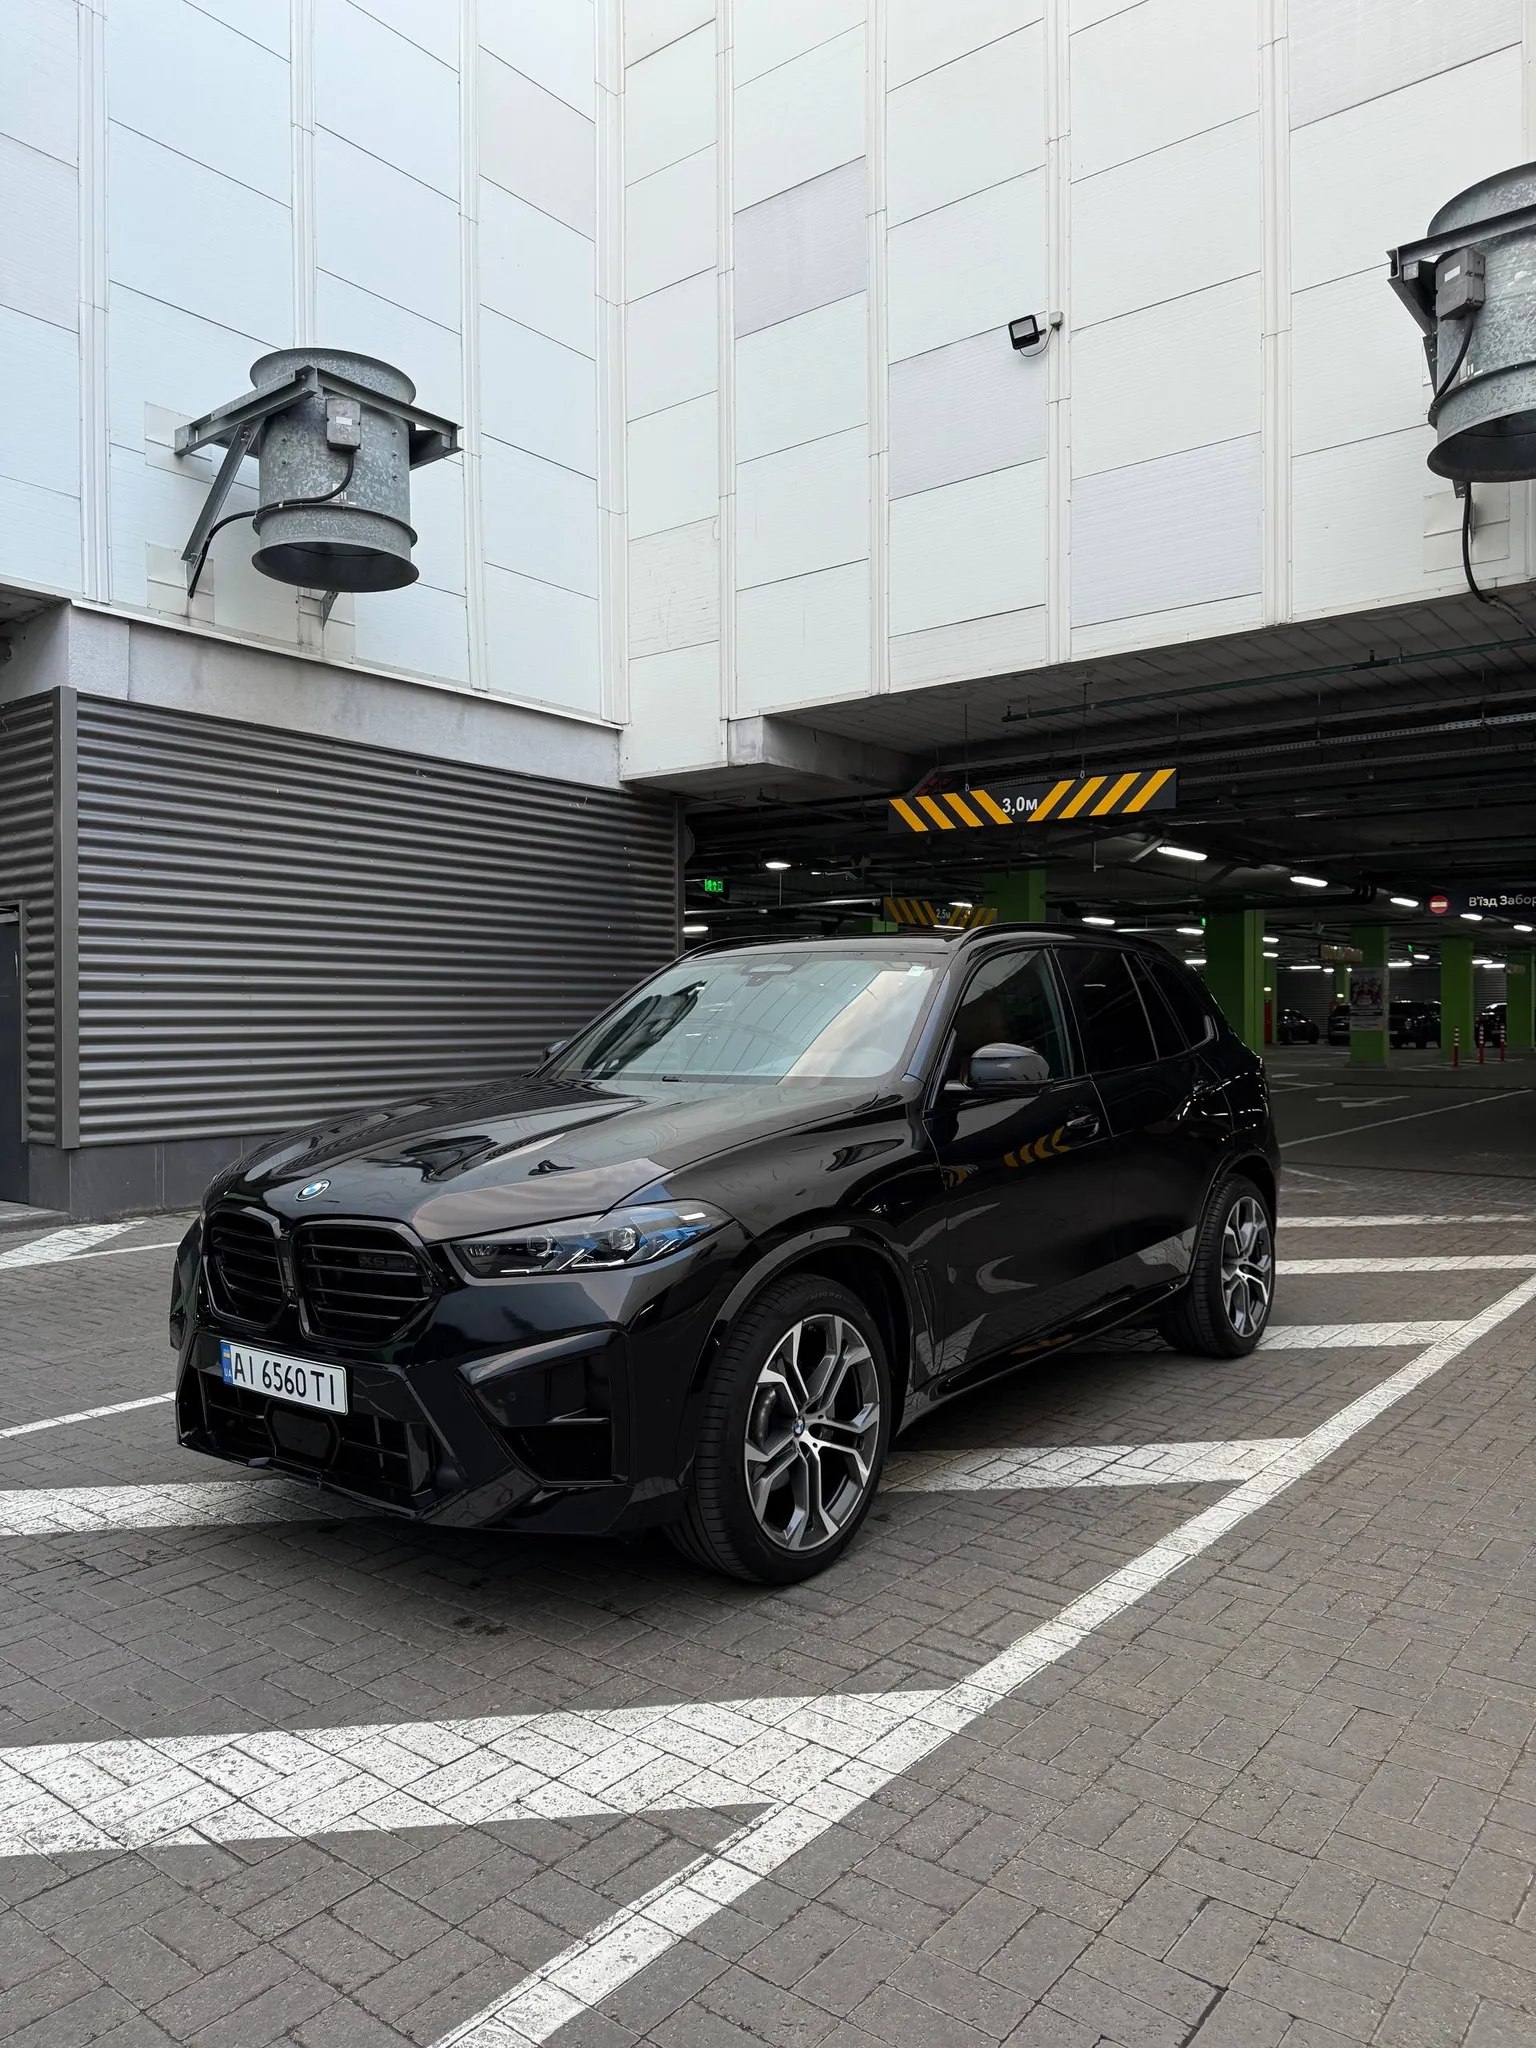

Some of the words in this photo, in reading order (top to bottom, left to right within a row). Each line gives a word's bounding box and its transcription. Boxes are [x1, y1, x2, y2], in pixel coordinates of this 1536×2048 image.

[1002, 796, 1038, 815] 3,0м
[1469, 896, 1498, 908] В'їзд
[234, 1352, 254, 1385] AI
[262, 1360, 307, 1398] 6560
[310, 1370, 335, 1405] TI
